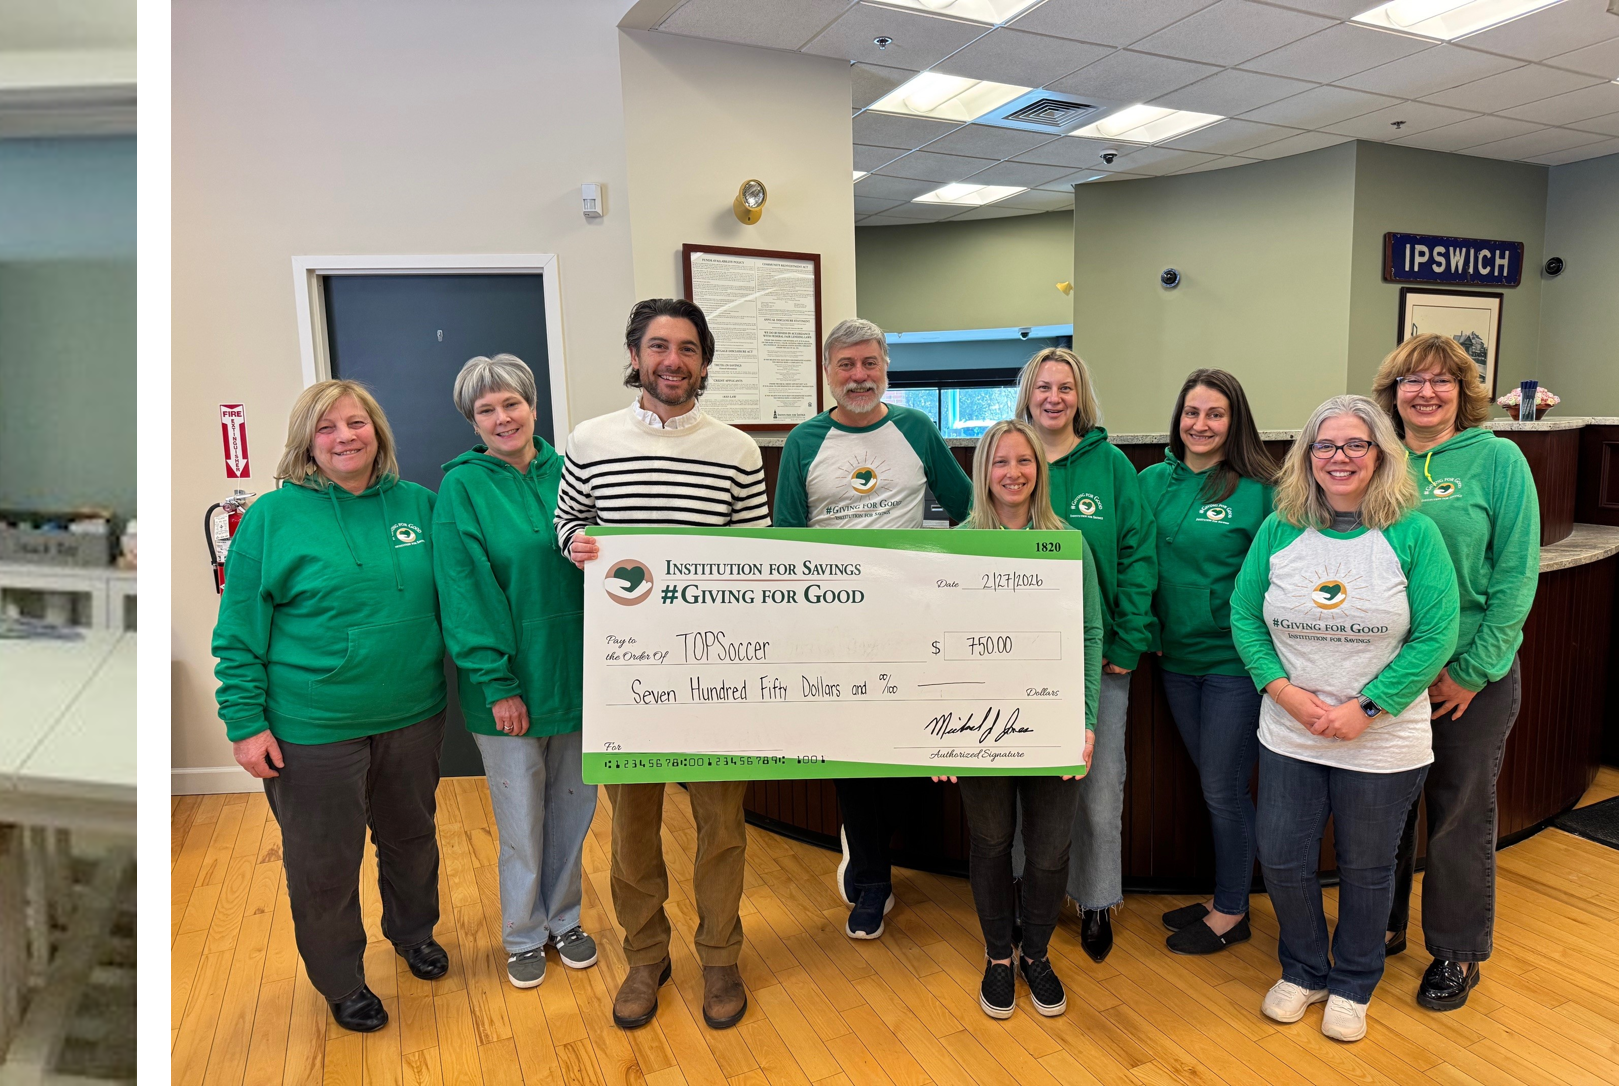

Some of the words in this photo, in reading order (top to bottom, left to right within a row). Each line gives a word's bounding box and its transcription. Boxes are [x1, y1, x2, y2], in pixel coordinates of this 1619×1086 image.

[1404, 243, 1510, 277] IPSWICH
[222, 410, 242, 418] FIRE
[825, 504, 861, 515] #GIVING
[862, 501, 878, 509] FOR
[1035, 541, 1062, 553] 1820
[664, 559, 763, 577] INSTITUTION
[768, 562, 798, 577] FOR
[802, 559, 862, 577] SAVINGS
[936, 578, 960, 589] Date
[981, 571, 1044, 593] 2/27/2026
[661, 583, 755, 605] #GIVING
[761, 589, 799, 604] FOR
[803, 583, 865, 605] GOOD
[1272, 617, 1322, 632] #GIVING
[1325, 623, 1348, 633] FOR
[1350, 622, 1389, 634] GOOD
[605, 634, 627, 649] Pay
[627, 636, 638, 645] to
[1287, 632, 1328, 642] INSTITUTION
[1343, 636, 1371, 644] SAVINGS
[675, 630, 771, 663] TOPSoccer
[931, 640, 941, 656] $
[966, 635, 1013, 657] 750.00
[605, 651, 621, 662] the
[622, 650, 651, 662] Order
[653, 650, 670, 664] Of
[631, 678, 677, 705] Seven
[689, 675, 748, 702] Hundred
[759, 674, 788, 701] Fifty
[801, 674, 841, 698] Dollars
[851, 680, 868, 696] and
[1025, 687, 1060, 697] Dollars
[603, 741, 623, 752] For
[796, 754, 826, 765] 1001
[928, 748, 981, 761] Authorized
[981, 748, 1025, 762] Signature
